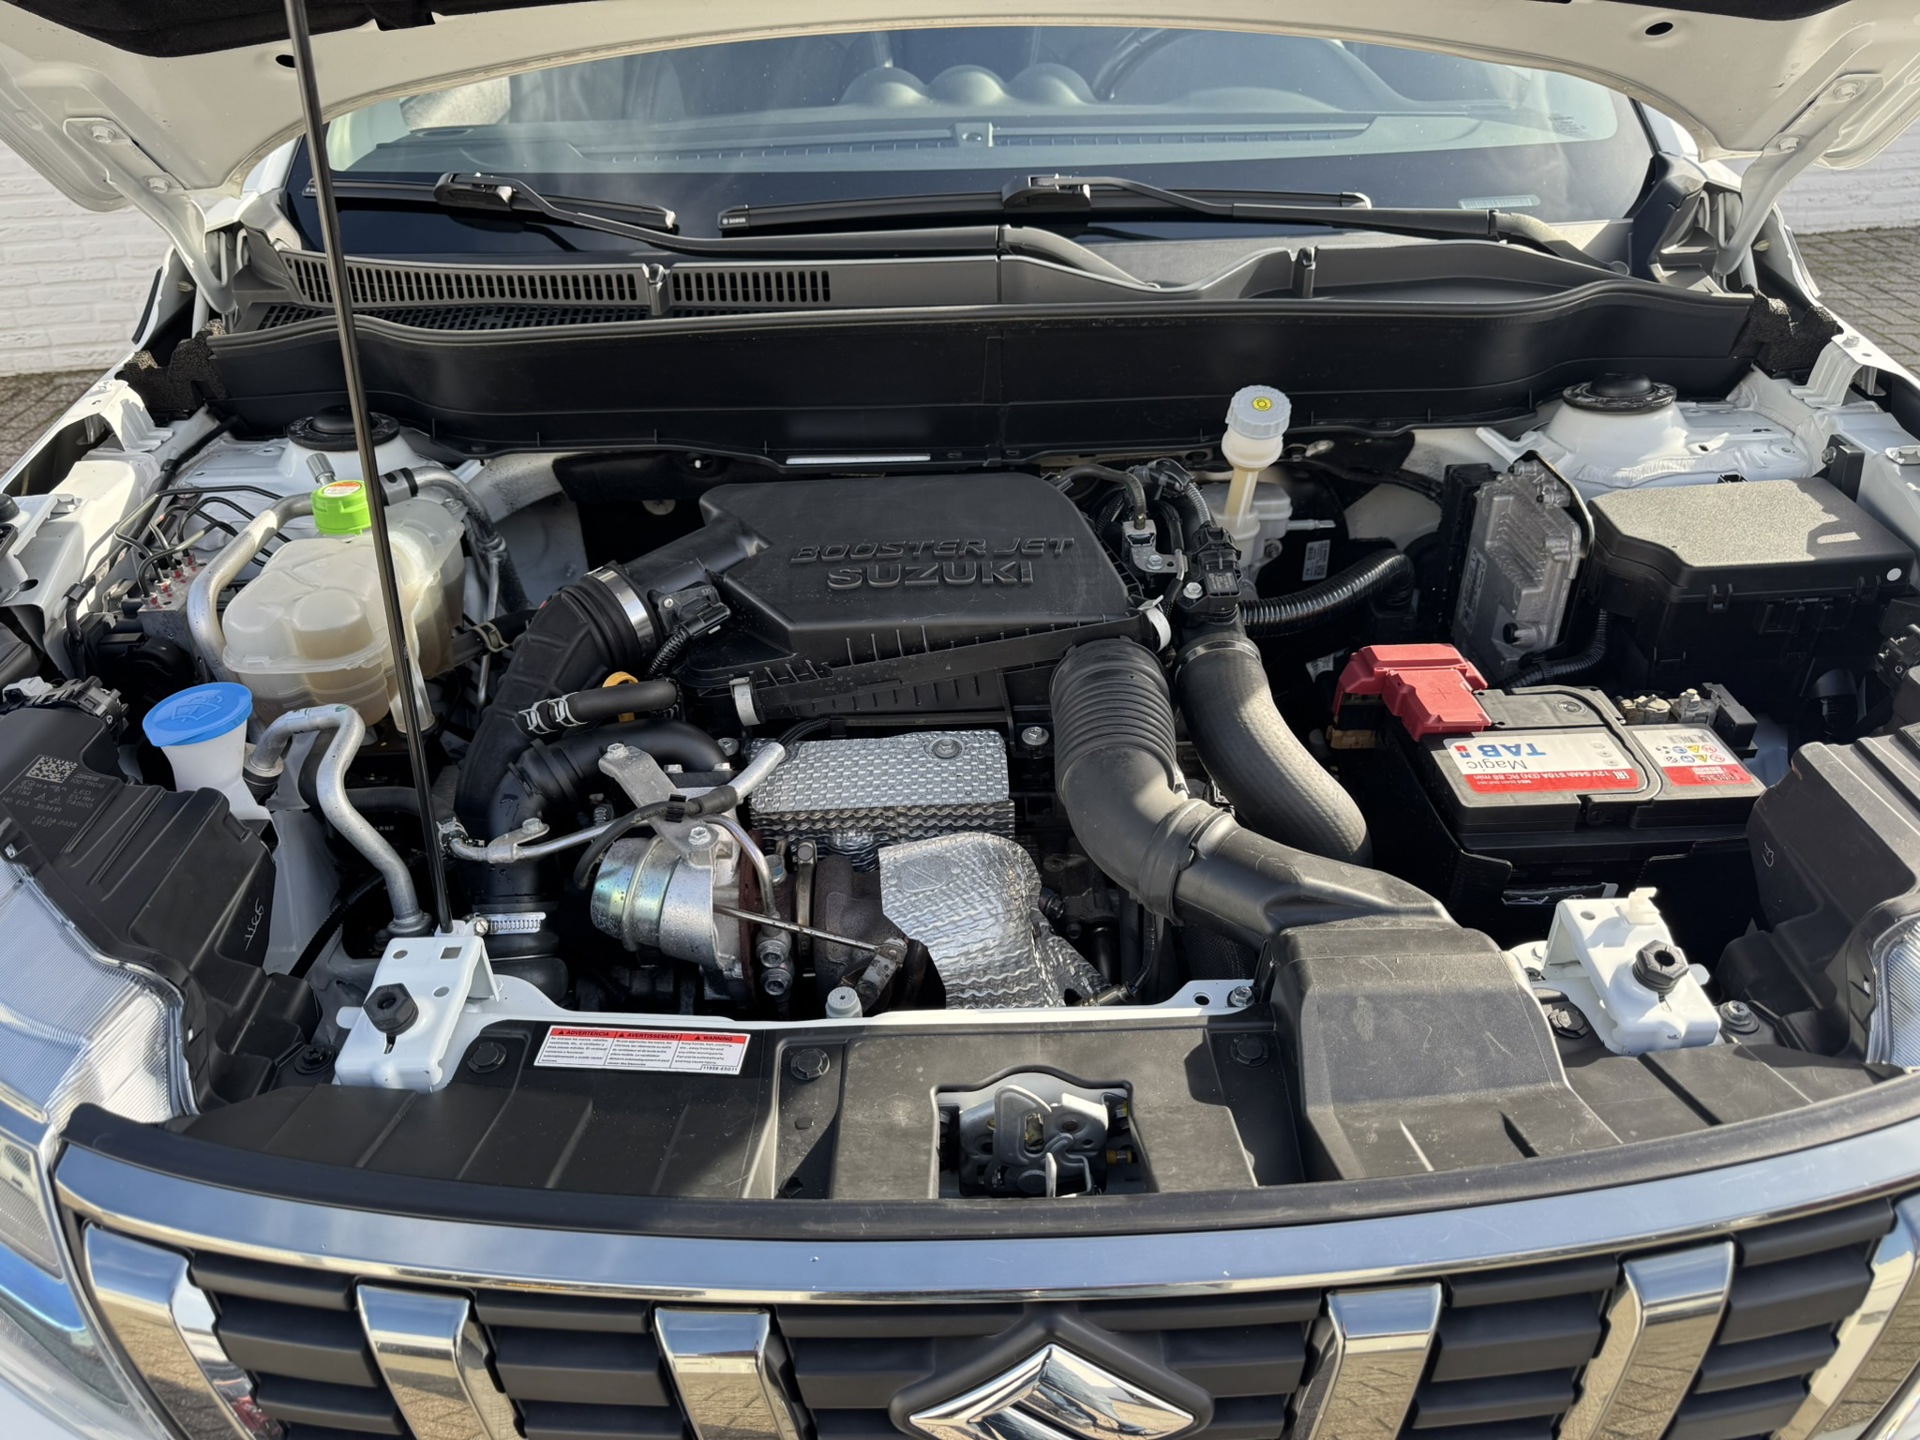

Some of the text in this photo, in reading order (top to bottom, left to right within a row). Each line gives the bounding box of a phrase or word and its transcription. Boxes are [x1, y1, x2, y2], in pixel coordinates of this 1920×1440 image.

[790, 537, 1076, 563] BOOSTER JET
[827, 560, 1034, 590] SUZUKI
[1477, 743, 1546, 757] TAB
[1466, 758, 1528, 771] Magic
